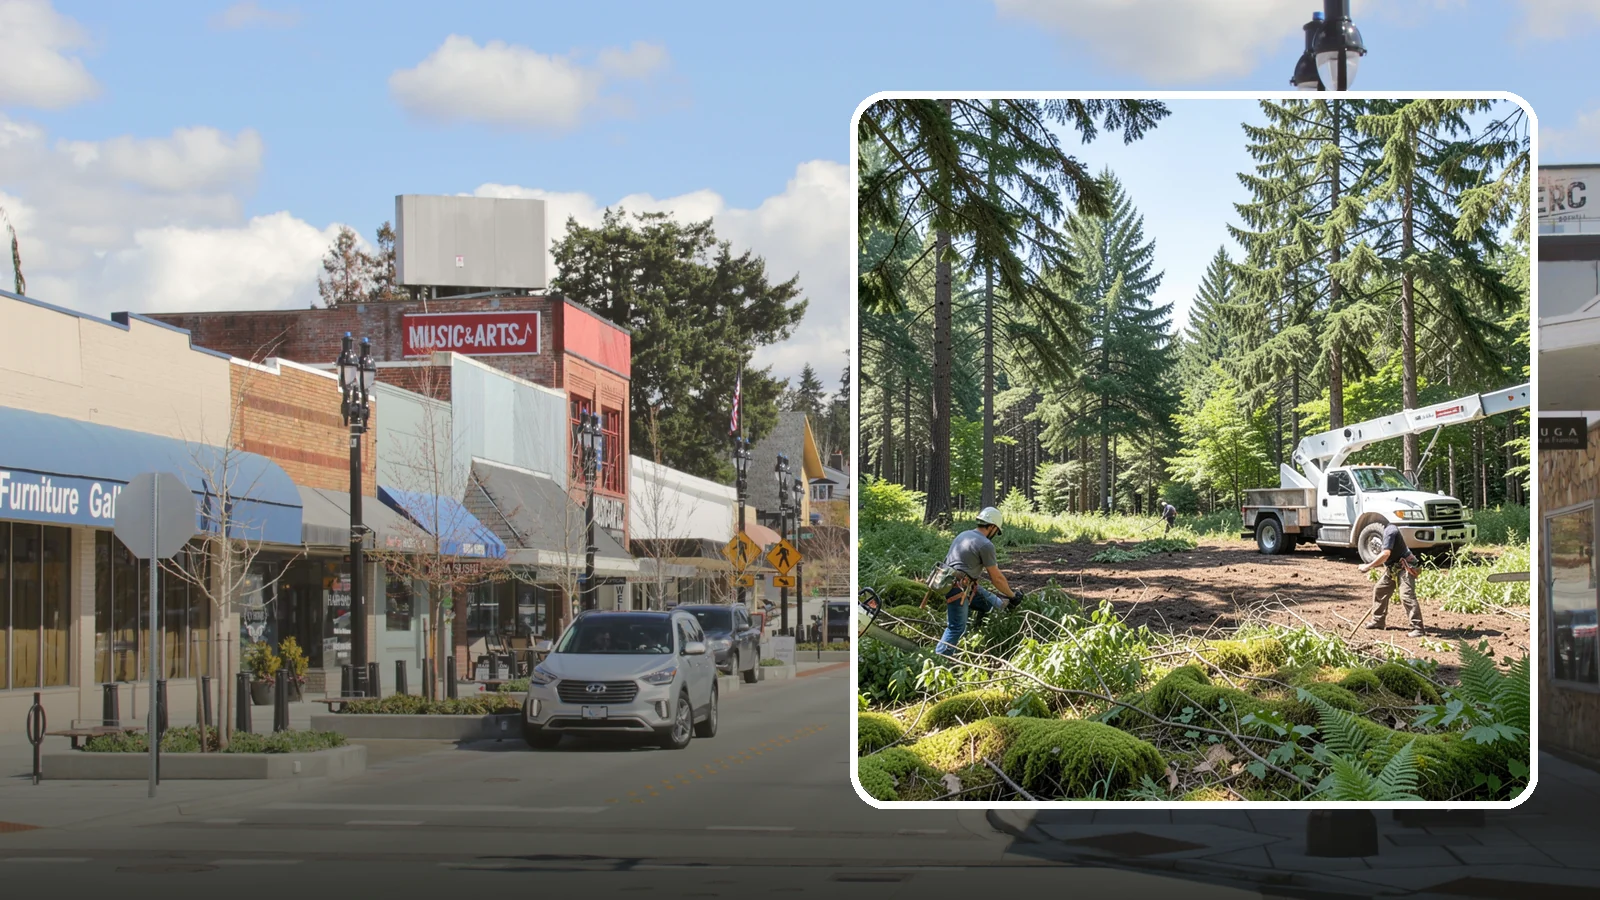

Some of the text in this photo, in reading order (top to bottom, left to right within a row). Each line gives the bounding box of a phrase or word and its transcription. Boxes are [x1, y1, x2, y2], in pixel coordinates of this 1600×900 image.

[1540, 427, 1577, 437] UGA
[0, 471, 79, 515] Furniture
[453, 563, 480, 574] SUSHI
